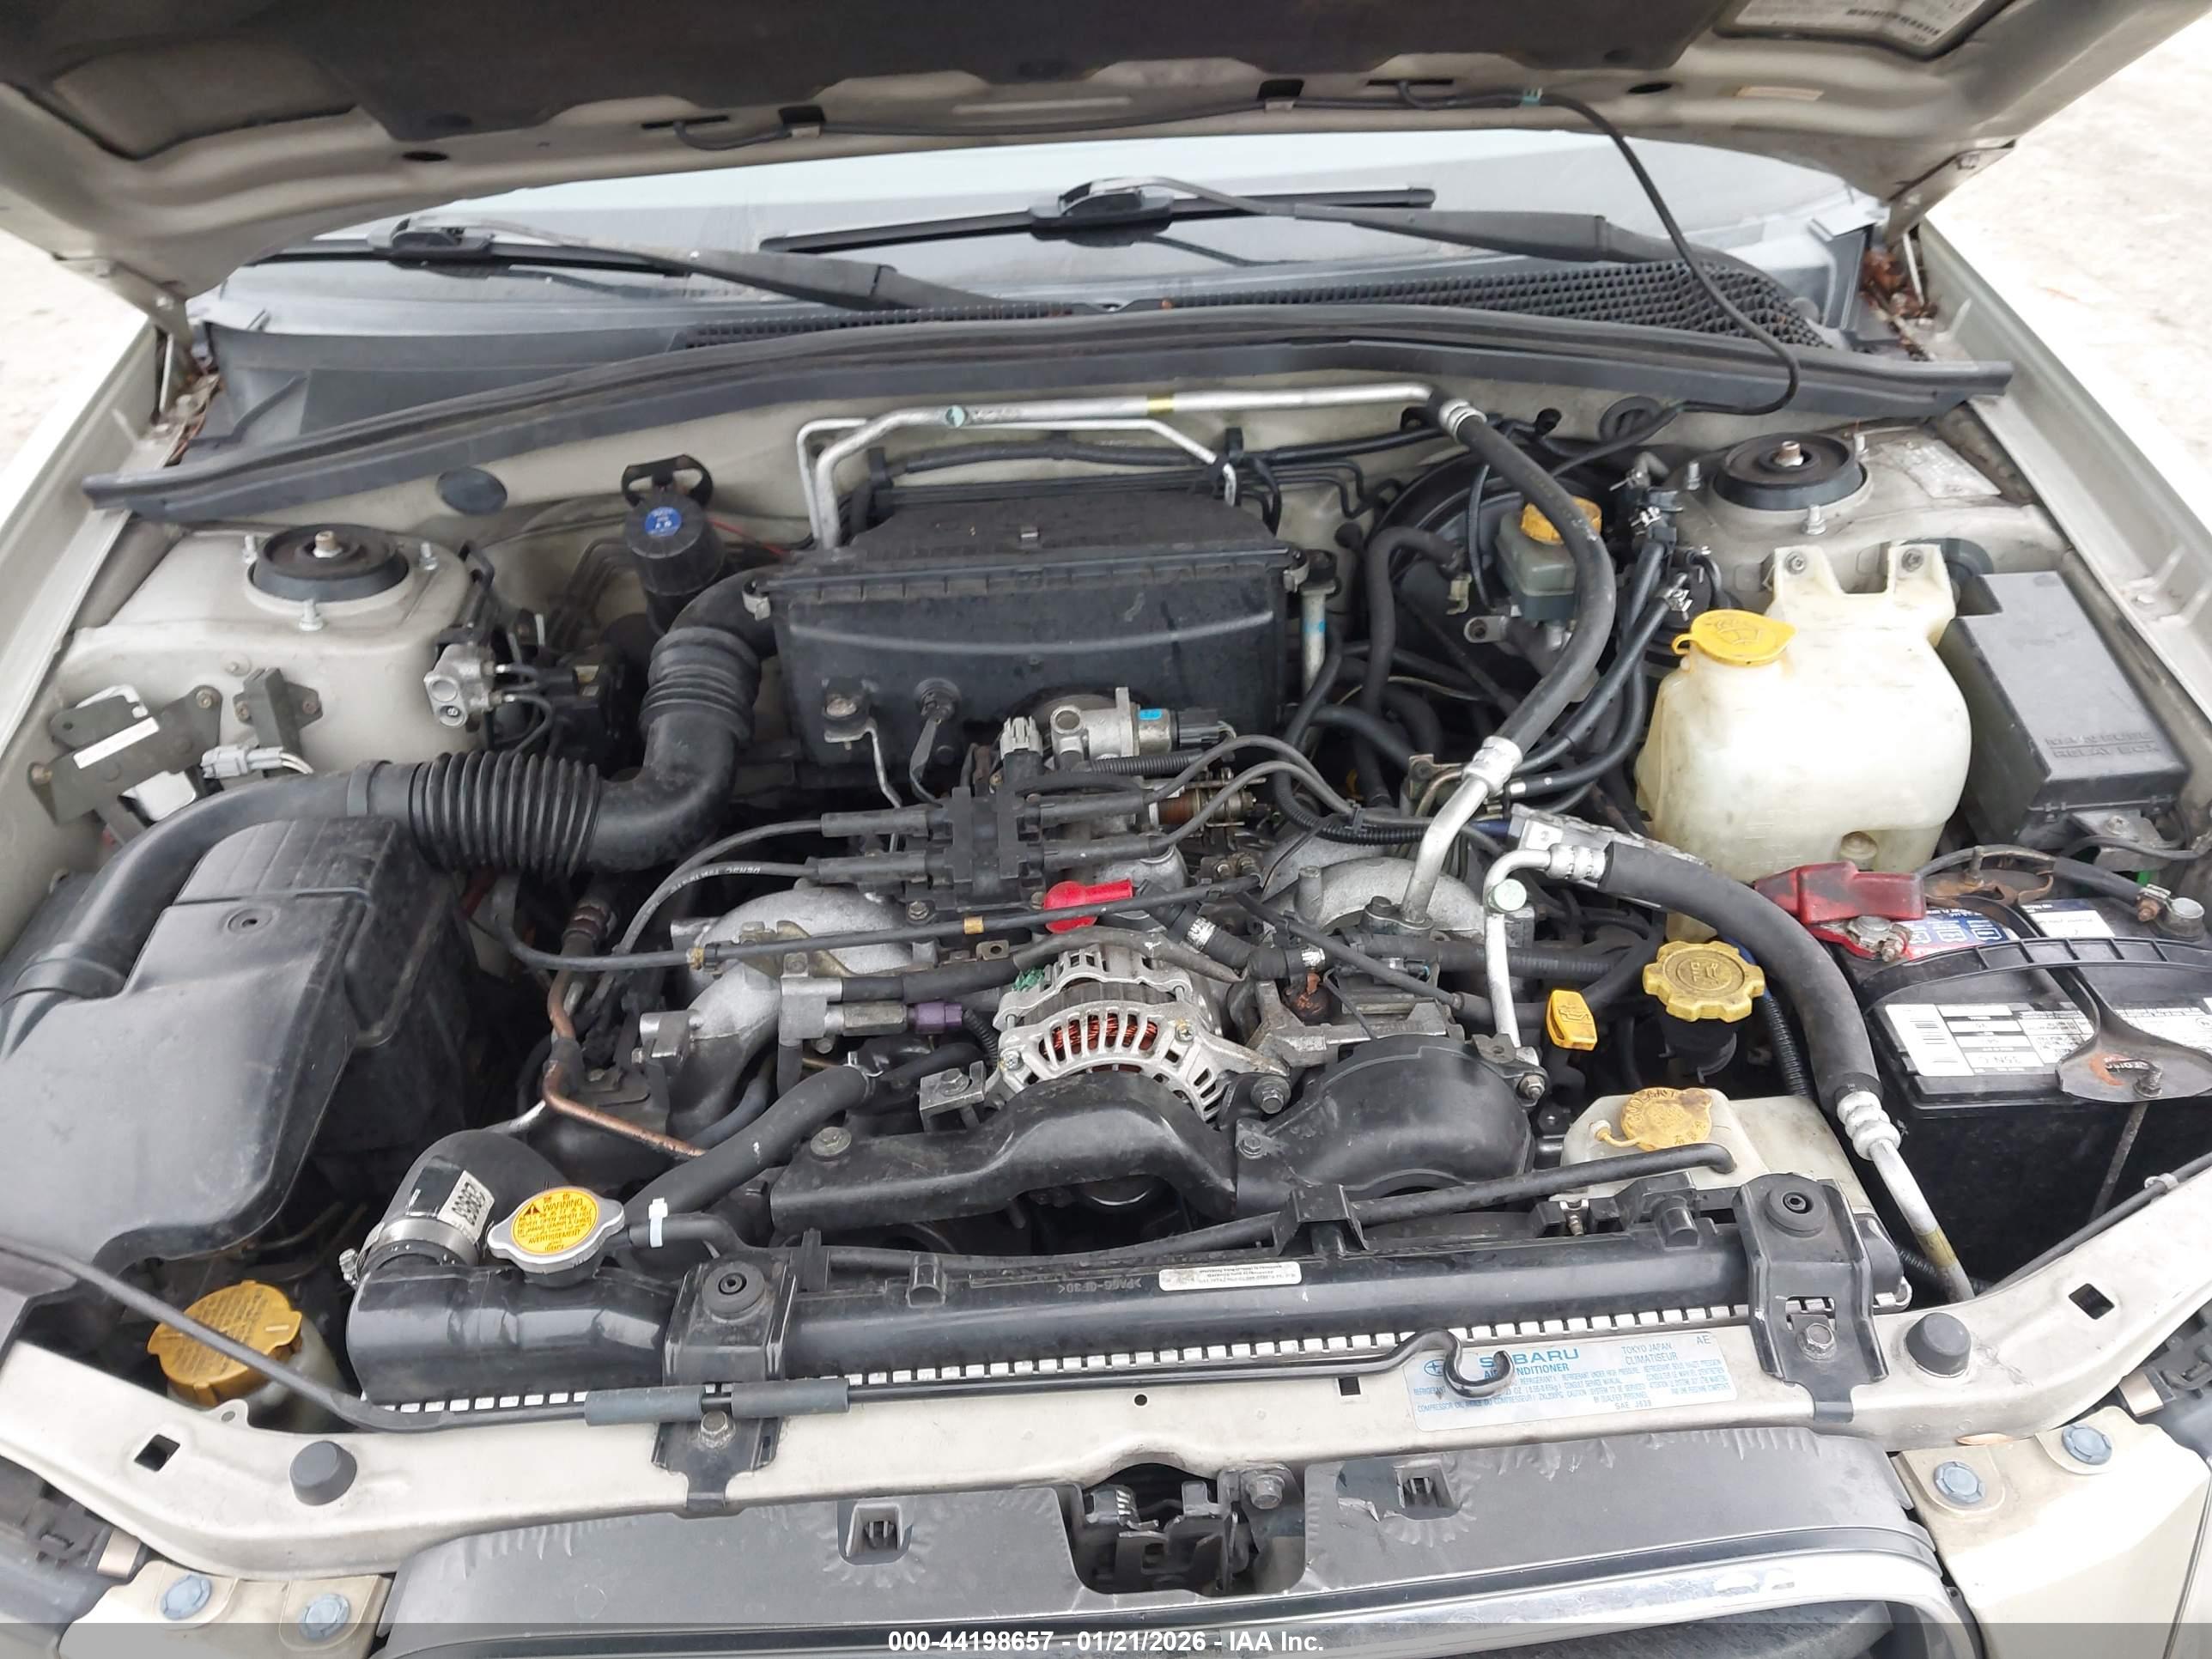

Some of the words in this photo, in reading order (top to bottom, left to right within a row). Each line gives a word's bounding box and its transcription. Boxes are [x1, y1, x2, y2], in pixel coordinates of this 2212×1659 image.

[1690, 961, 1701, 981] OIL
[543, 1198, 583, 1212] WARNING
[1696, 1334, 1711, 1345] AE
[1620, 1344, 1646, 1354] TOKYO
[1648, 1341, 1671, 1352] JAPAN
[1479, 1348, 1579, 1368] SBARU
[1625, 1352, 1677, 1364] CLIMATISEUR
[1516, 1363, 1569, 1375] NDITIONER
